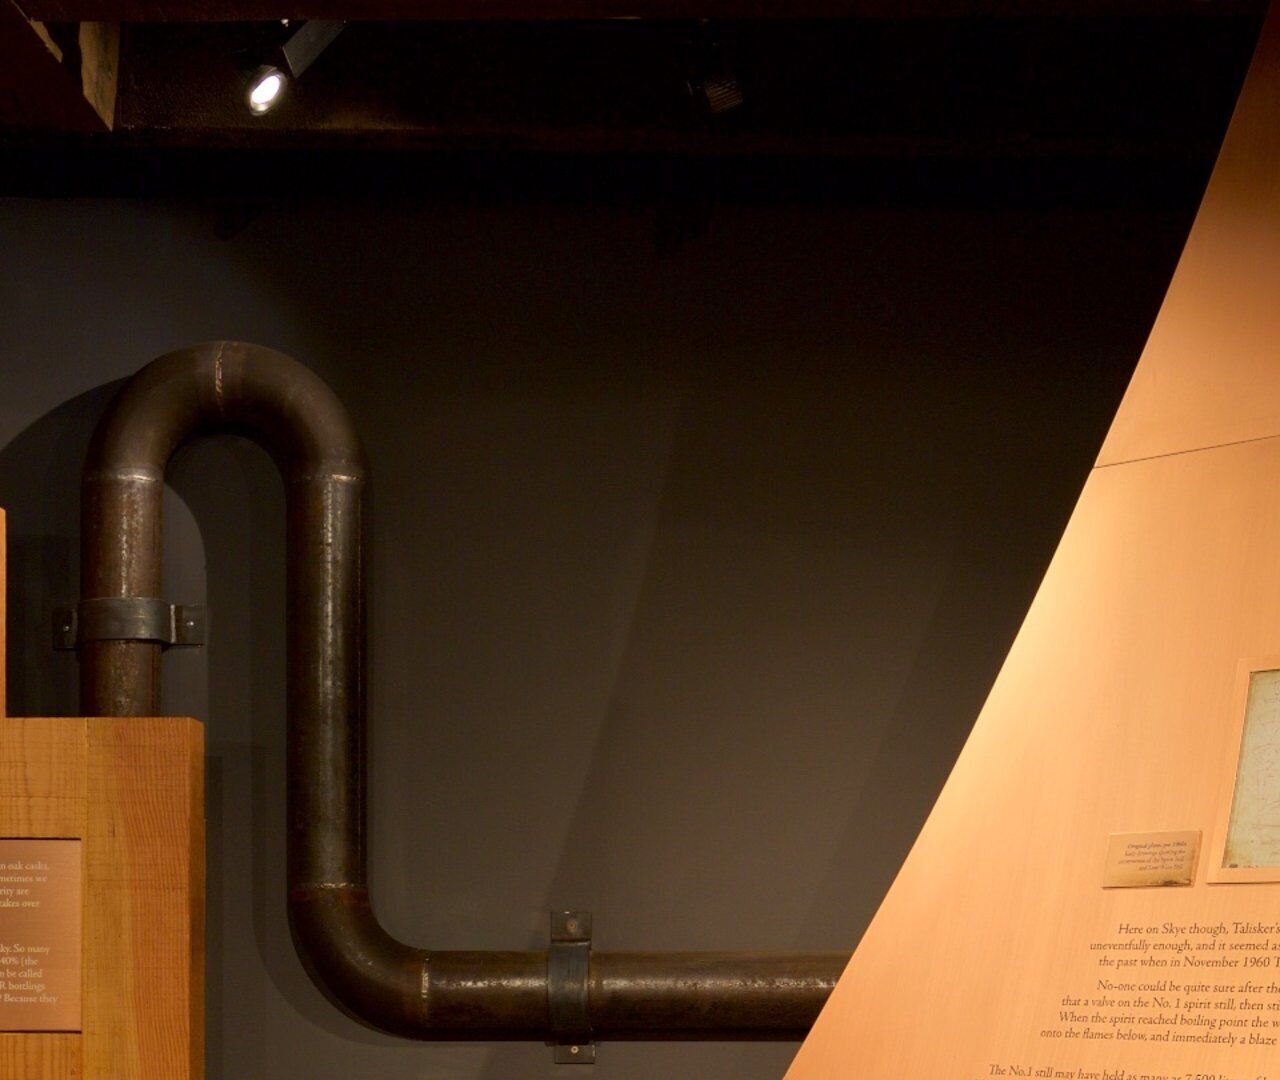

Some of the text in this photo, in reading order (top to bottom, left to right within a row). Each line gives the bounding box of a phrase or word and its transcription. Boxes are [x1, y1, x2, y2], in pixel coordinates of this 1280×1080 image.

[1118, 922, 1145, 935] Here
[1146, 926, 1159, 935] on
[1161, 922, 1187, 938] Skye
[1188, 921, 1230, 938] though,
[1098, 954, 1115, 967] the
[1115, 958, 1140, 971] past
[1140, 955, 1168, 967] when
[1170, 956, 1181, 968] in
[1183, 955, 1241, 968] November
[1243, 956, 1271, 968] 1960
